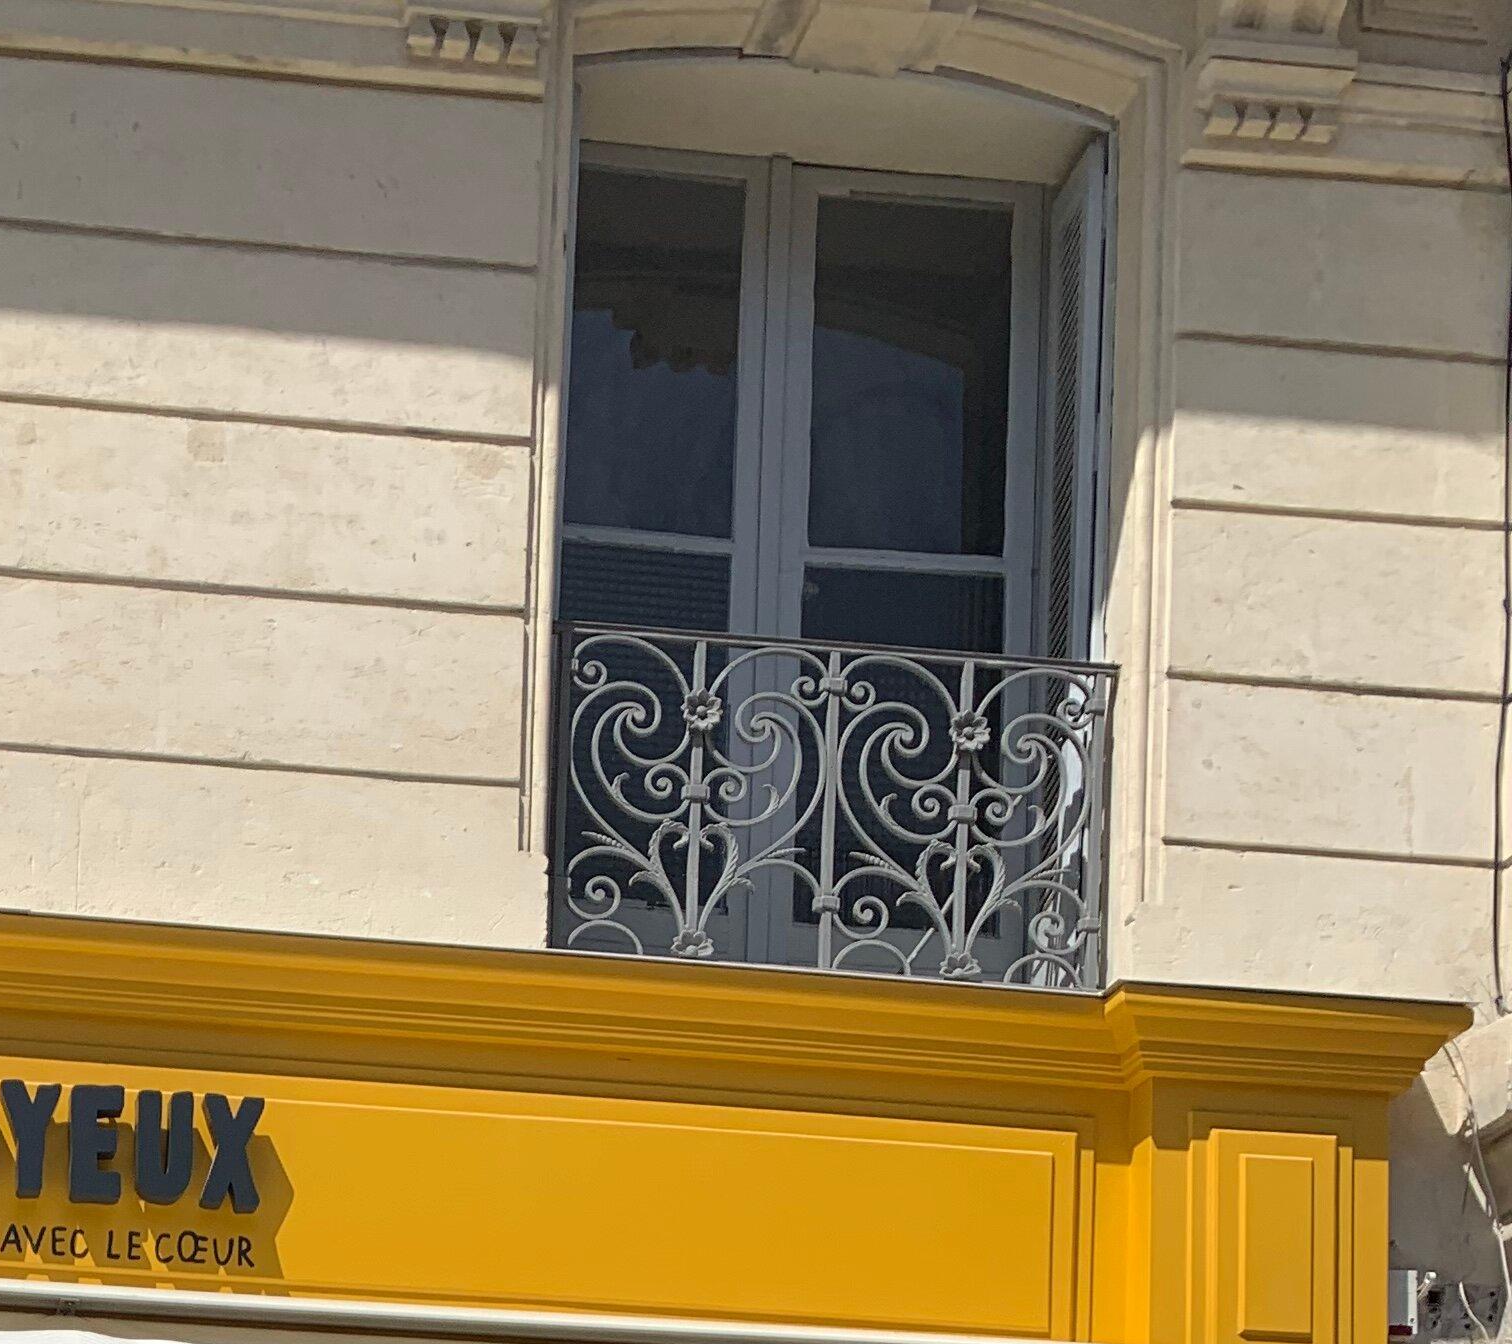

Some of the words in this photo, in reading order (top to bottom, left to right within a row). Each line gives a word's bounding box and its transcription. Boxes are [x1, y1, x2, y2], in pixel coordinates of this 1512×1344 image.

[0, 1227, 89, 1260] AVEC
[107, 1230, 143, 1262] LE
[154, 1232, 256, 1268] CŒUR
